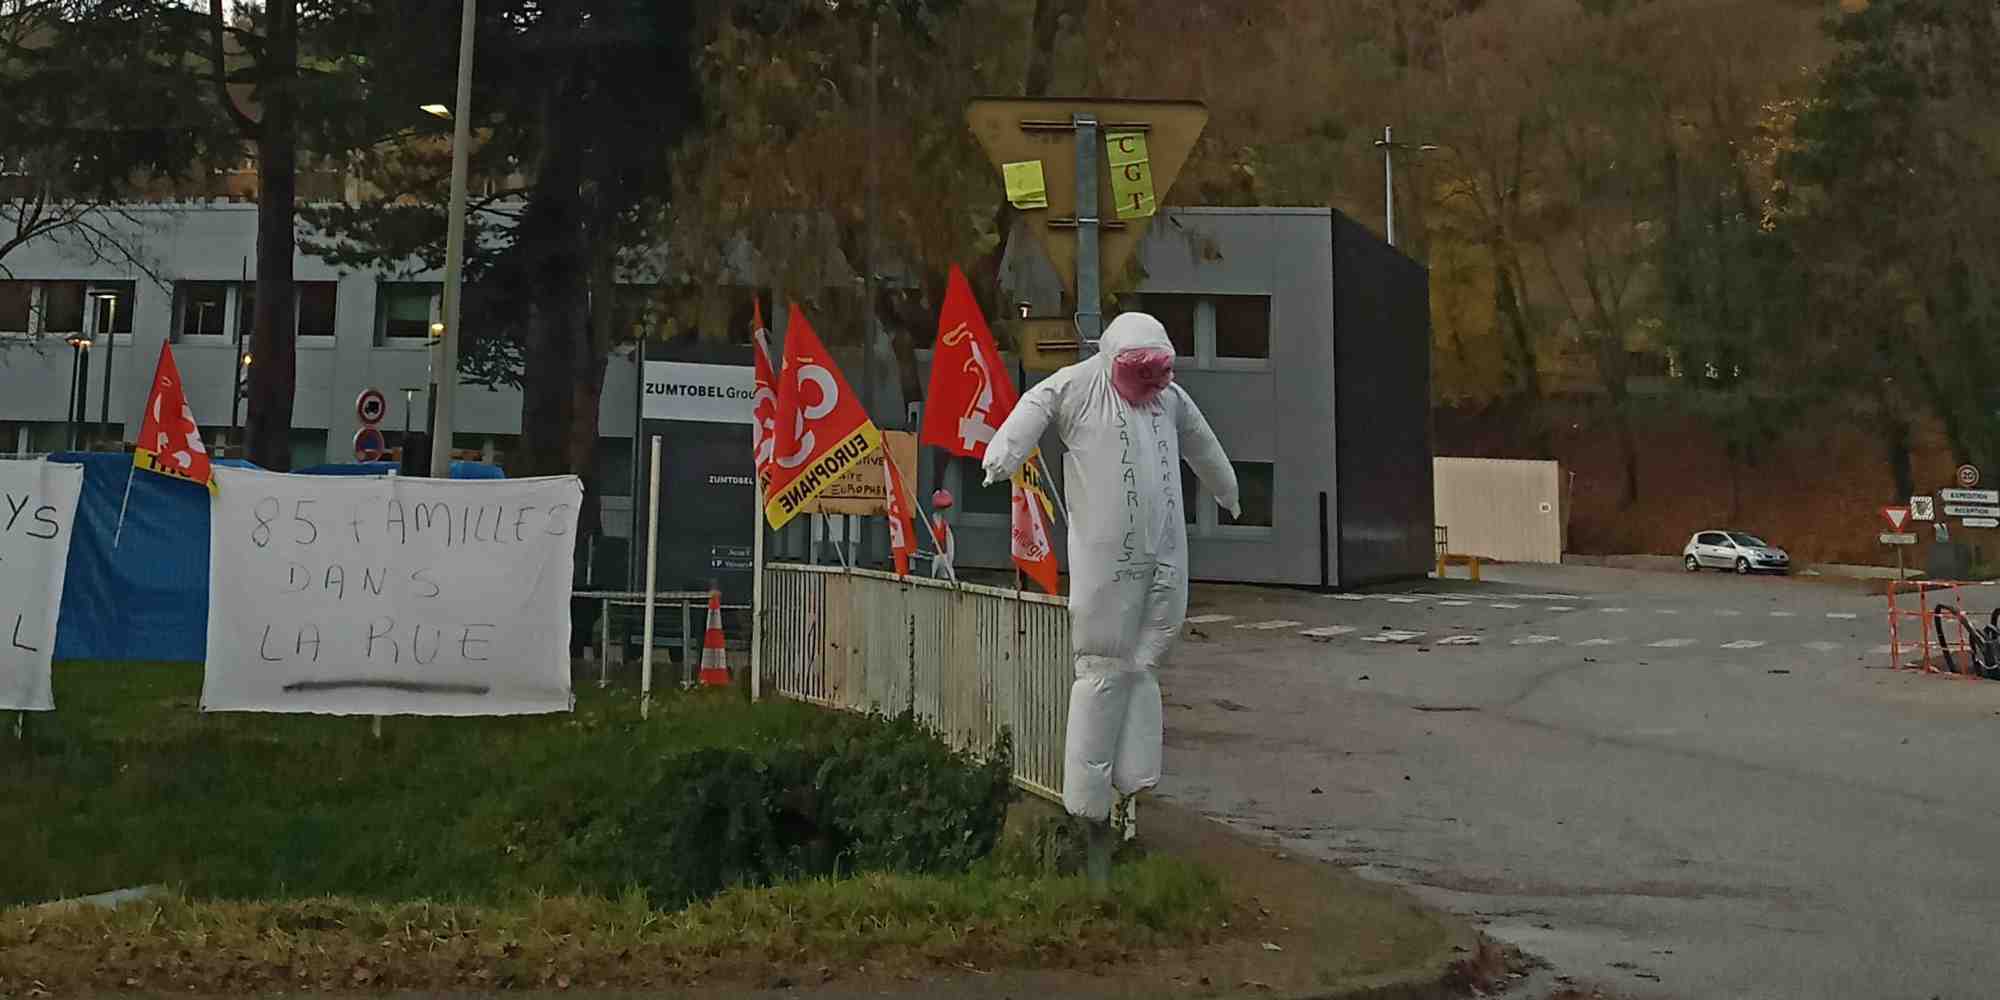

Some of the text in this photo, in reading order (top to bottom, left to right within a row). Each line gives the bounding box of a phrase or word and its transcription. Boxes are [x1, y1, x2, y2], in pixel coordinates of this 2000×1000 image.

[1119, 136, 1144, 210] CGT
[645, 382, 756, 400] ZUMTOBEL Grou
[709, 475, 754, 486] ZUMTOBEL
[6, 493, 60, 540] YS
[250, 496, 318, 548] 85
[282, 561, 440, 601] DANS
[259, 616, 496, 666] LA RUE
